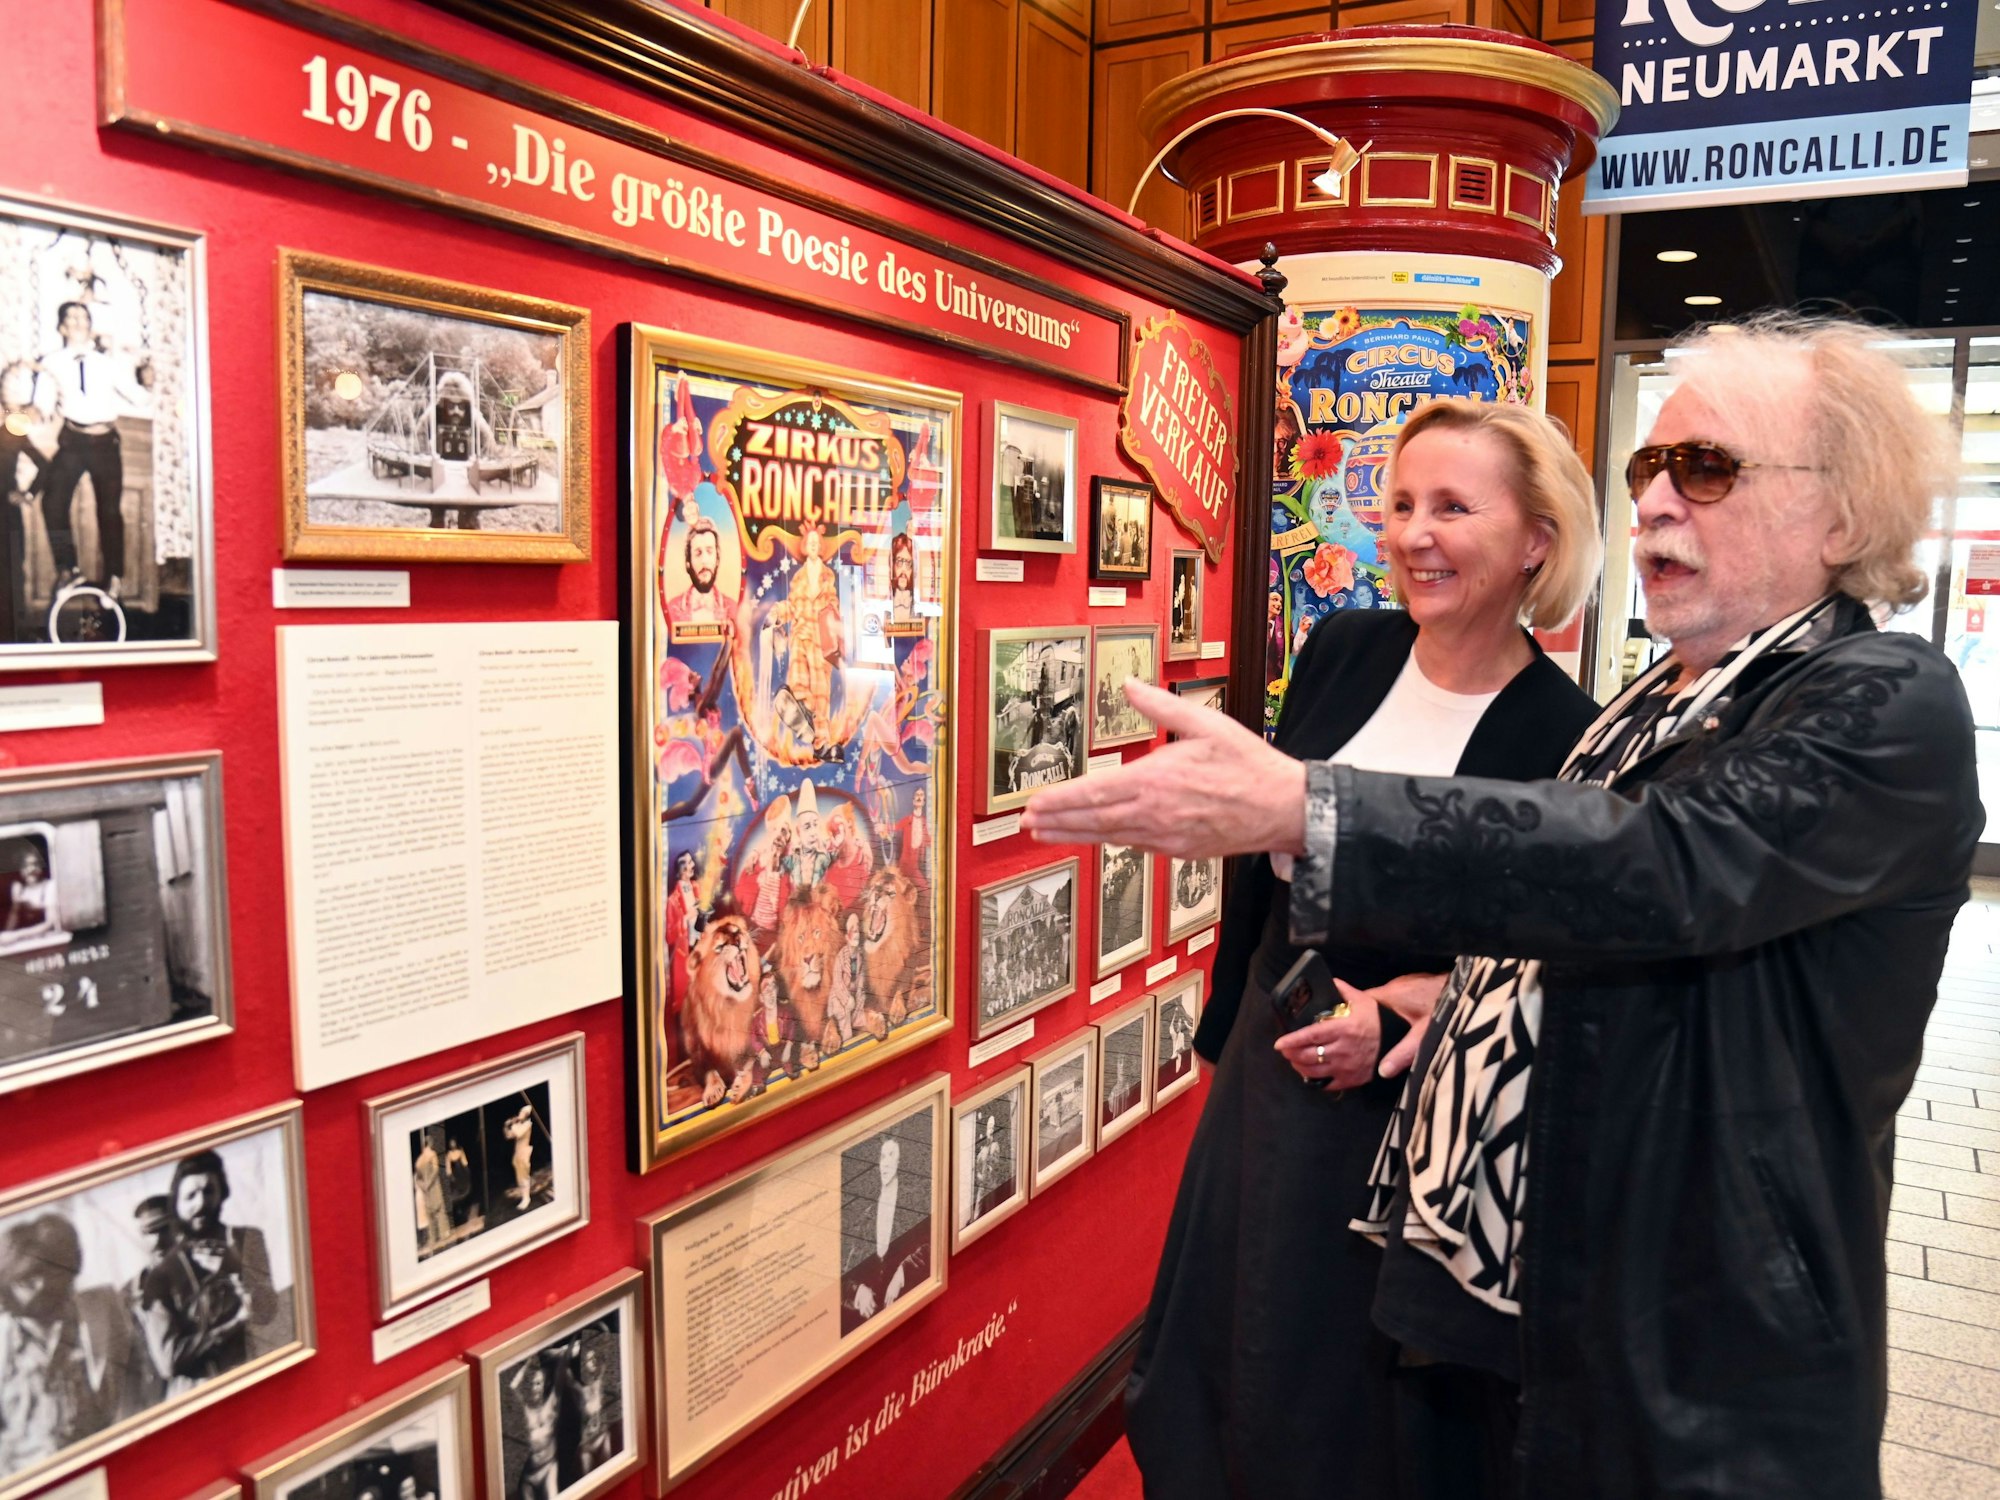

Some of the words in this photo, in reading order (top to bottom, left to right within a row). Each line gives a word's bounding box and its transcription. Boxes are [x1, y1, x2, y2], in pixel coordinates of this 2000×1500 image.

[1621, 26, 1944, 106] NEUMARKT
[1602, 124, 1951, 190] WWW.RONCALLI.DE
[301, 54, 433, 152] 1976
[486, 123, 596, 202] „Die
[611, 172, 746, 248] größte
[757, 206, 868, 286] Poesie
[877, 251, 927, 304] des
[934, 268, 1081, 350] Universums“
[1345, 343, 1455, 376] CIRCUS
[1364, 334, 1409, 344] BERNHARD
[1159, 340, 1227, 467] FREIER
[1308, 387, 1483, 424] RONC
[1369, 367, 1432, 390] Theater
[746, 422, 880, 470] ZIRKUS
[1139, 371, 1228, 520] VERKAUF
[741, 455, 882, 530] RONCALLI
[1020, 761, 1067, 791] RONCALLI
[845, 1423, 872, 1461] ist
[873, 1391, 906, 1436] die
